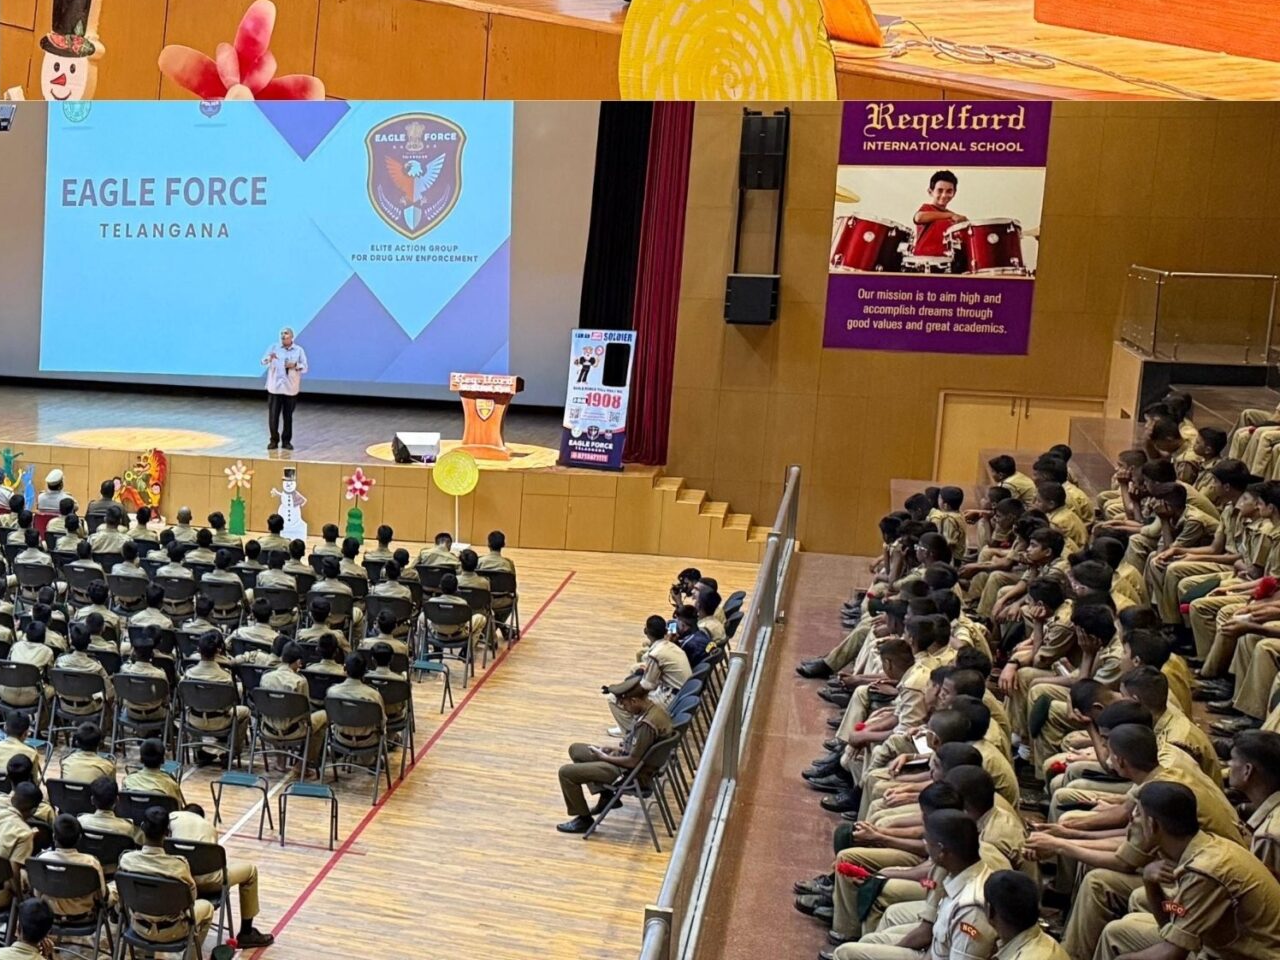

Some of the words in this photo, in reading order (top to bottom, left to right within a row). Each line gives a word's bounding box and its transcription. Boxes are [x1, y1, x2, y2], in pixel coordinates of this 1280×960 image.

[375, 134, 406, 142] EAGLE
[424, 133, 457, 141] FORCE
[863, 141, 966, 152] INTERNATIONAL
[969, 141, 1024, 152] SCHOOL
[62, 178, 155, 206] EAGLE
[166, 177, 267, 206] FORCE
[100, 223, 228, 238] TELANGANA
[370, 244, 393, 252] ELITE
[394, 244, 426, 252] ACTION
[351, 254, 368, 262] FOR
[370, 254, 393, 262] DRUG
[395, 254, 413, 262] LAW
[857, 287, 875, 300] Our
[876, 288, 913, 301] mission
[915, 289, 924, 301] is
[927, 290, 937, 302] to
[939, 291, 957, 302] aim
[959, 291, 981, 305] high
[983, 293, 1002, 304] and
[863, 304, 916, 318] accomplish
[918, 305, 953, 317] dreams
[956, 306, 993, 320] through
[847, 318, 870, 331] good
[872, 318, 903, 330] values
[905, 319, 923, 331] and
[926, 321, 951, 334] great
[953, 322, 1007, 334] academics.
[585, 392, 622, 409] 1908
[962, 924, 977, 936] NCC
